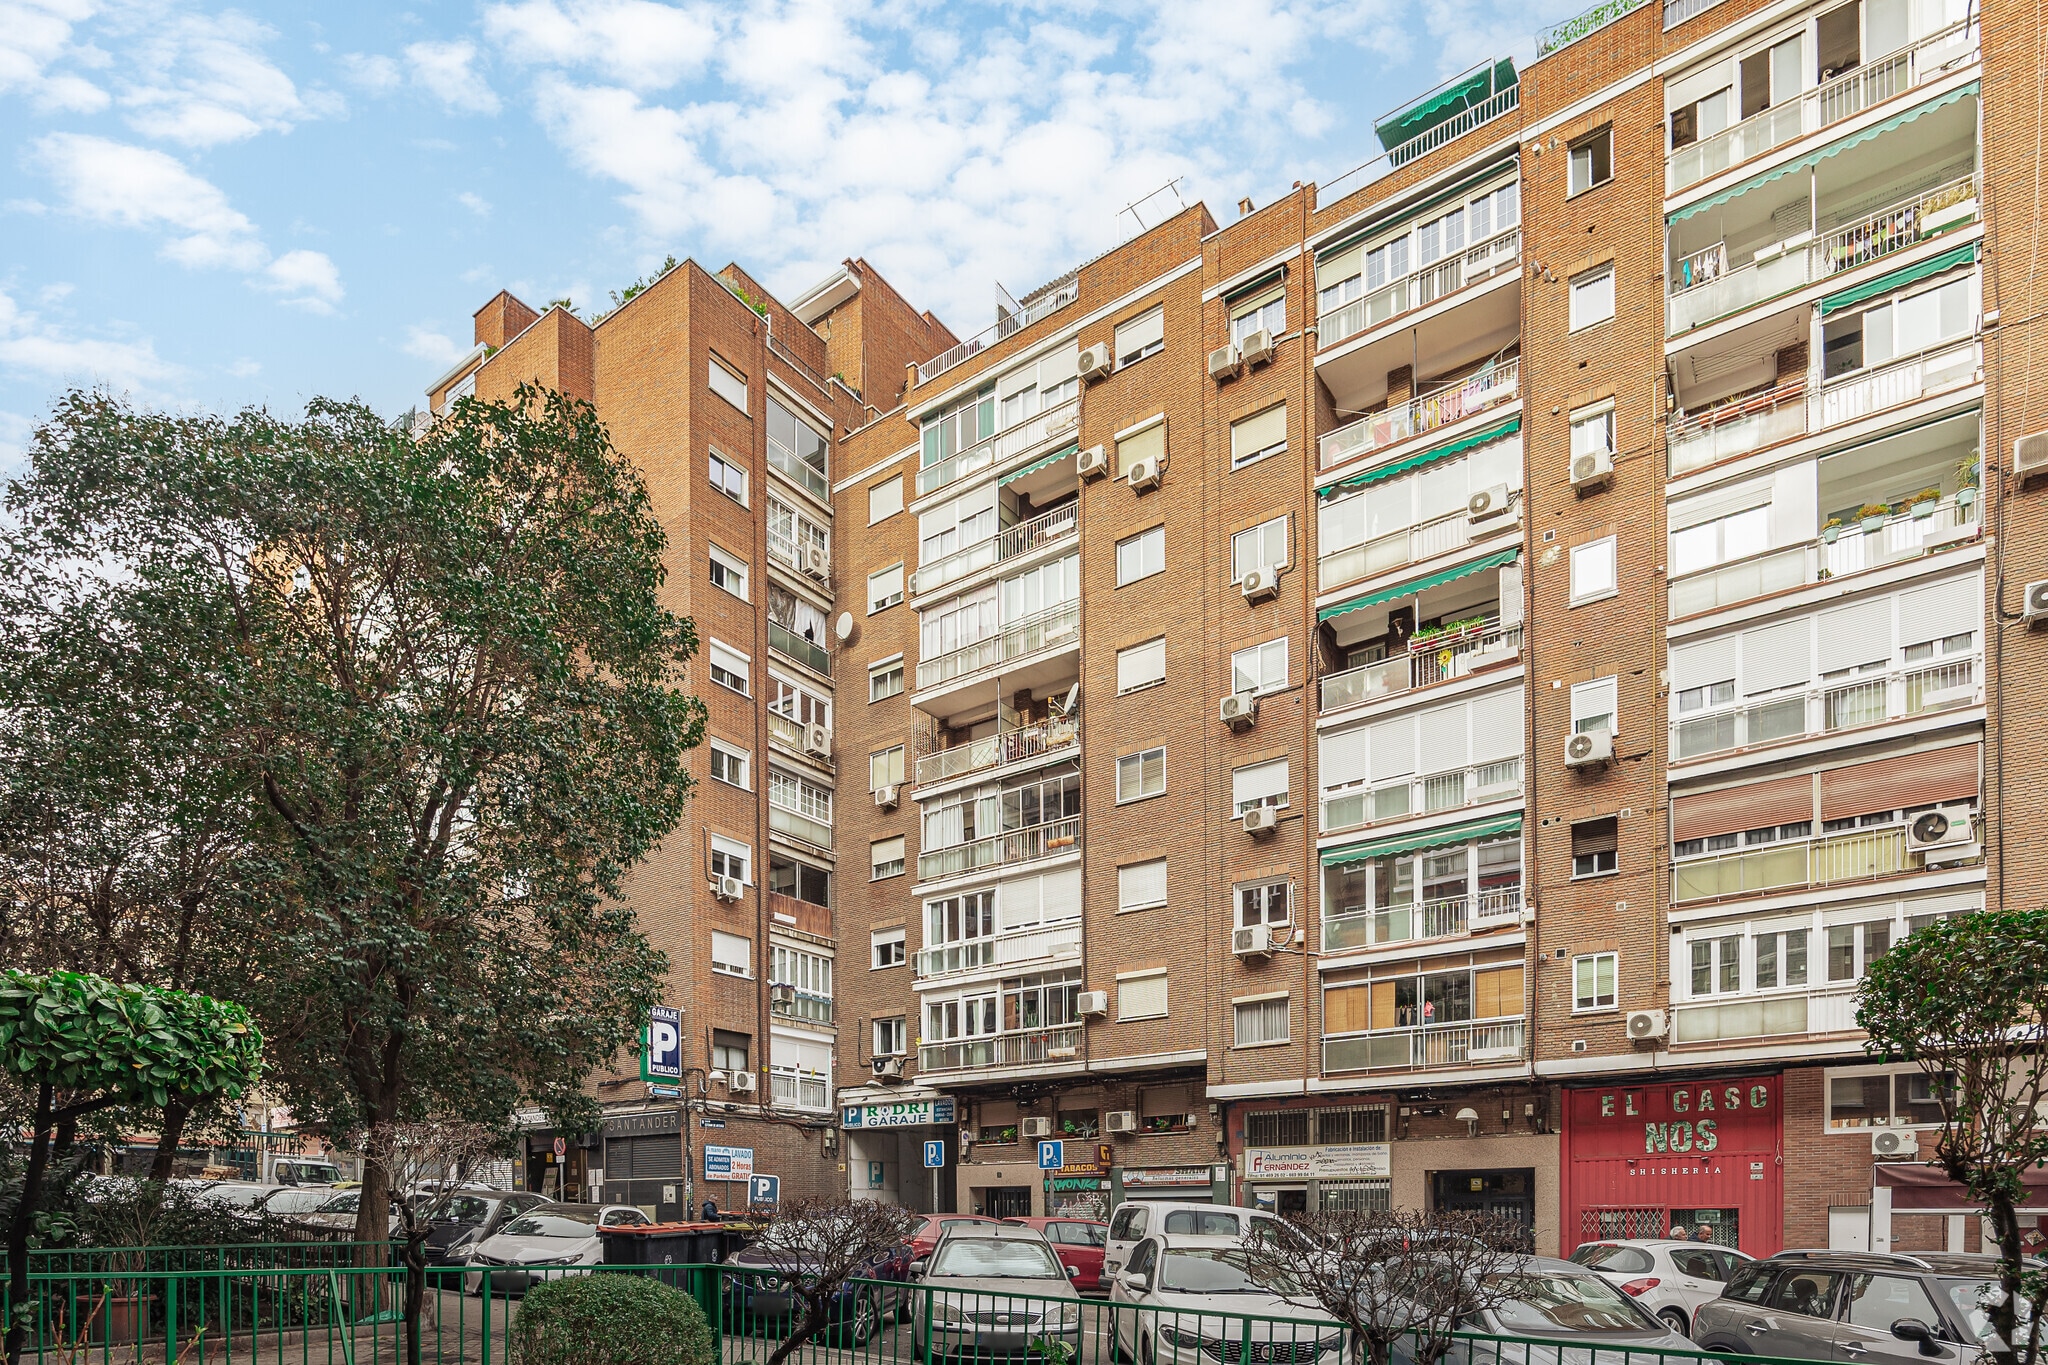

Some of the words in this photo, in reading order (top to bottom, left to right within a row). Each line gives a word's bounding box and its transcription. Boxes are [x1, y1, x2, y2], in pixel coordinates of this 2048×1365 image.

[652, 1008, 677, 1020] GARAJE
[653, 1022, 677, 1063] P
[652, 1065, 678, 1074] PUBLICO
[1602, 1095, 1639, 1117] EL
[1673, 1085, 1767, 1113] CASO
[848, 1107, 857, 1122] P
[868, 1114, 927, 1126] GARAJE
[609, 1115, 677, 1132] SANTANDER
[1645, 1119, 1718, 1154] NOS
[732, 1150, 751, 1159] LAVADO
[928, 1144, 936, 1164] P
[1043, 1144, 1053, 1165] P
[1264, 1153, 1307, 1161] Aluminio
[732, 1161, 736, 1169] 2
[737, 1162, 751, 1170] Horas
[1061, 1164, 1098, 1172] TABACOS
[1630, 1166, 1721, 1176] SHISHERIA
[758, 1179, 770, 1196] P
